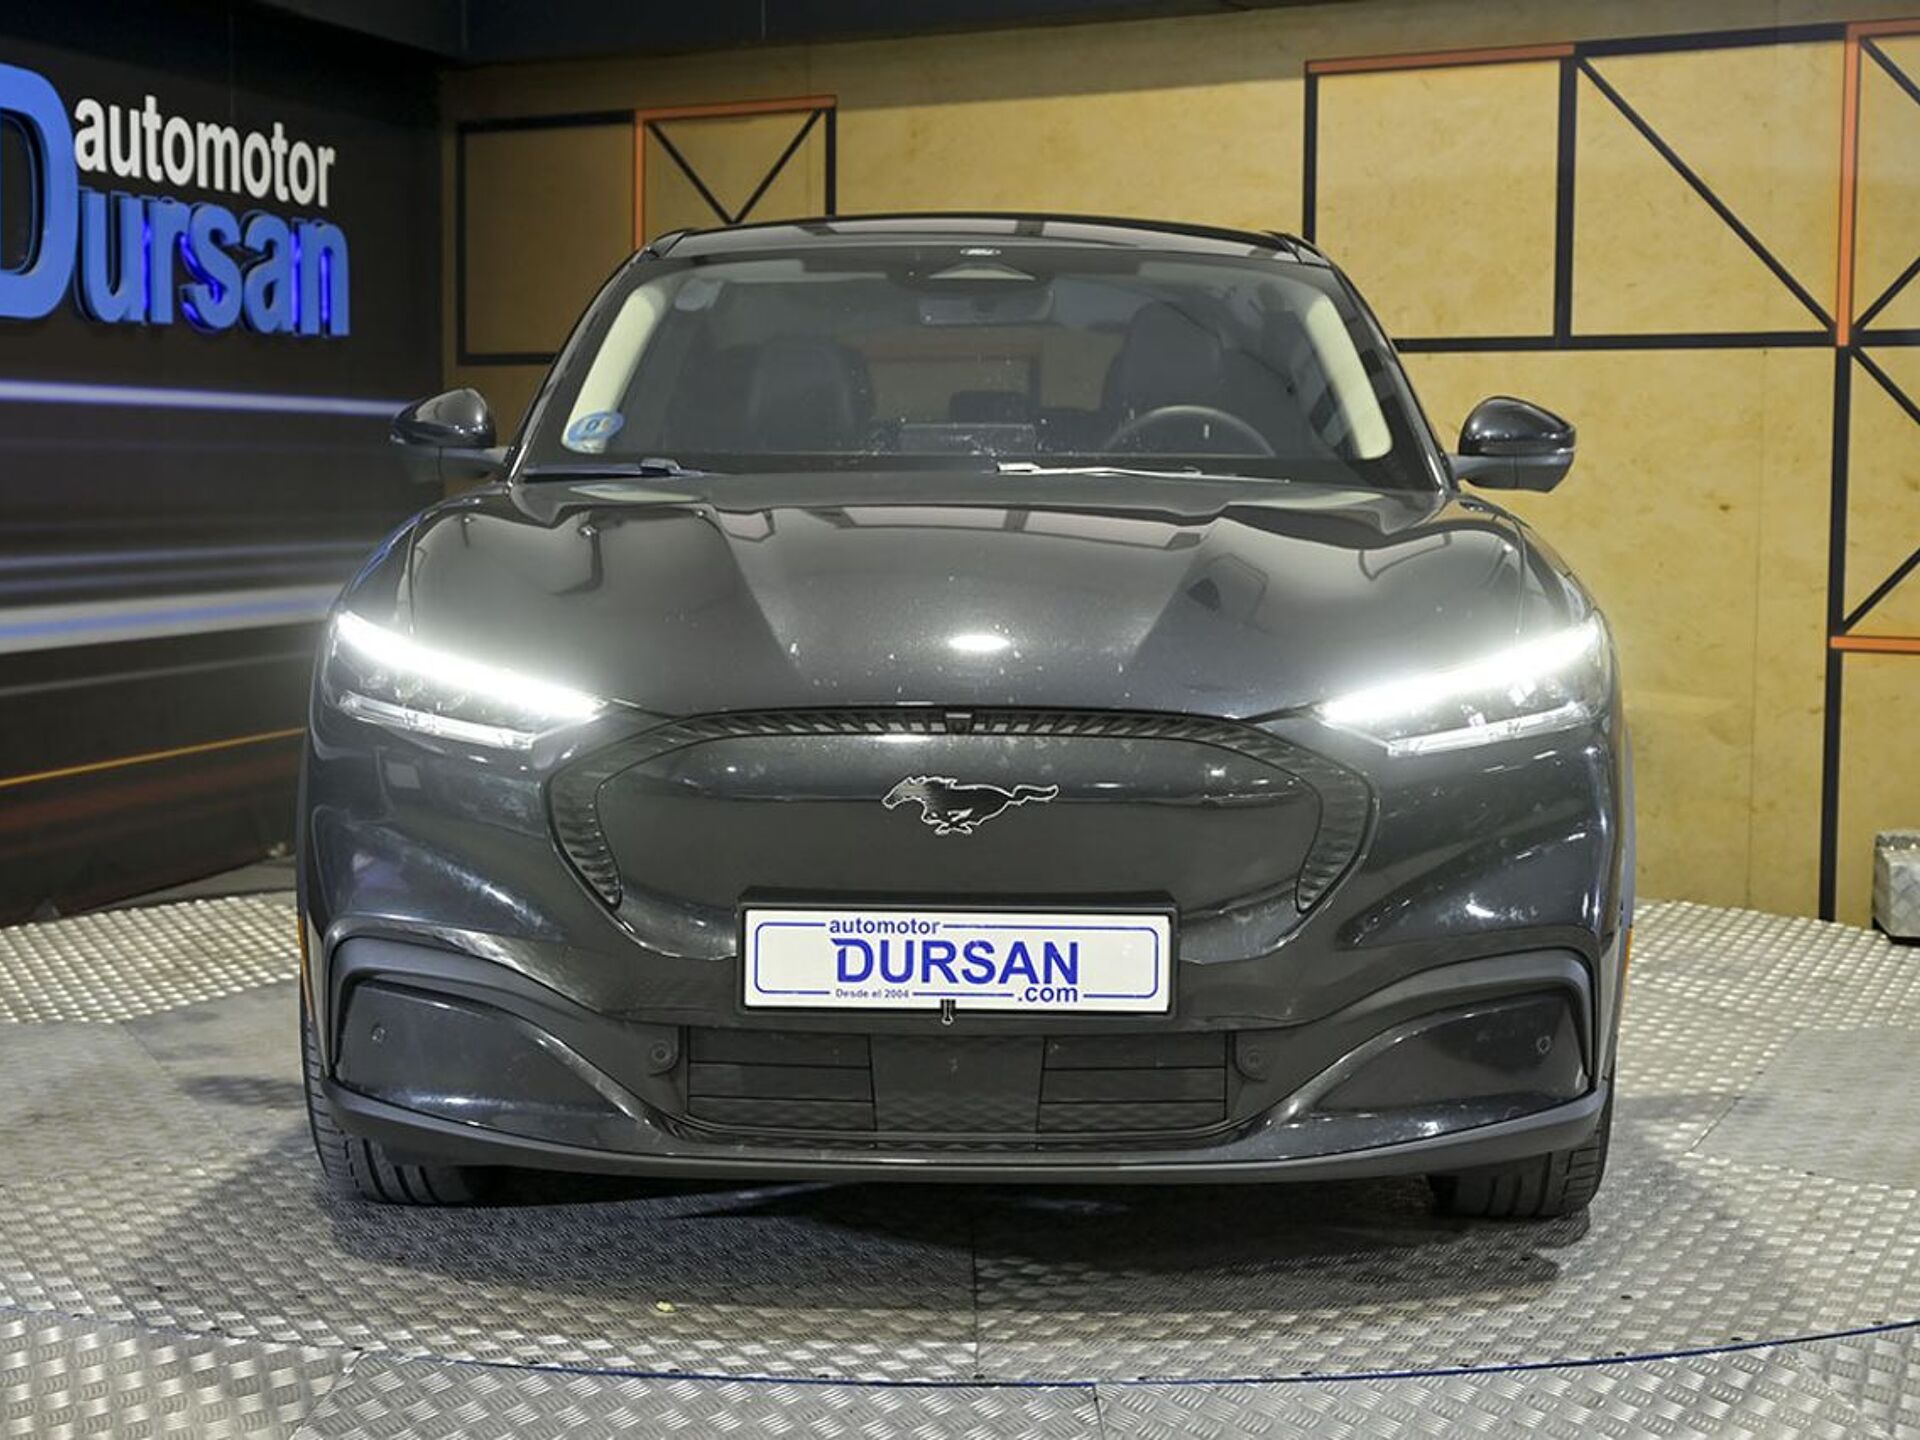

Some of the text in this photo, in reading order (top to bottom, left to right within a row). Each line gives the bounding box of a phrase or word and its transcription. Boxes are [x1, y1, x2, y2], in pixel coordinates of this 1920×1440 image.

[74, 95, 335, 207] automotor
[829, 918, 941, 934] automotor
[830, 938, 1078, 985] DURSAN
[836, 988, 868, 998] Desde
[871, 989, 881, 998] el
[1017, 986, 1078, 1002] .com
